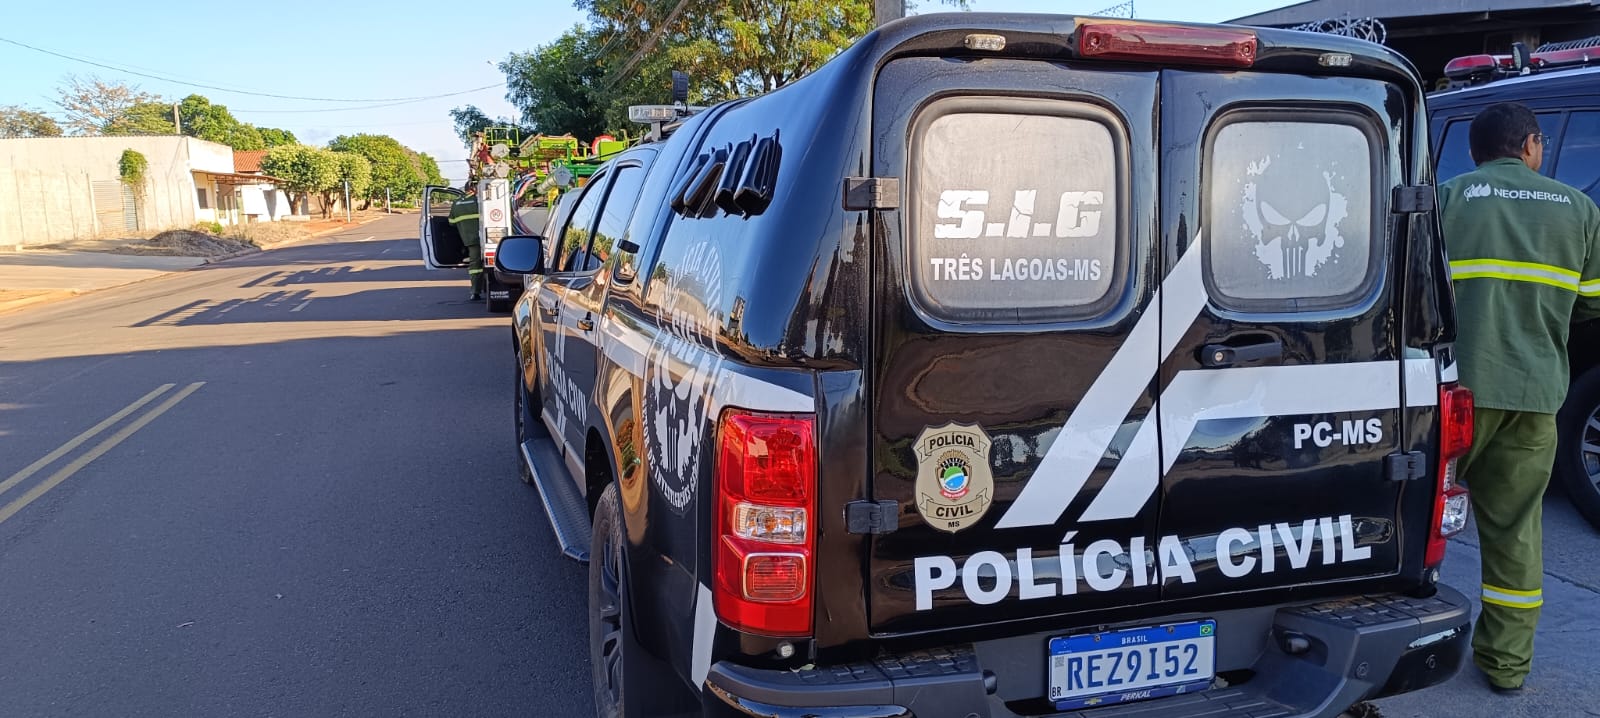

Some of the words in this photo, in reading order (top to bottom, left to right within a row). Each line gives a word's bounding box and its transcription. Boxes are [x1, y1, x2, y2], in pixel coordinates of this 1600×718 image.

[1493, 187, 1571, 205] NEOENERGIA
[934, 189, 1104, 239] S.I.G
[931, 253, 983, 281] TRÊS
[990, 258, 1102, 281] LAGOAS-MS
[929, 432, 975, 450] POLÍCIA
[1293, 418, 1383, 449] PC-MS
[936, 505, 974, 518] CIVIL
[914, 530, 1196, 611] POLÍCIA
[1215, 513, 1372, 578] CIVIL
[1121, 636, 1148, 645] BRASIL
[1067, 643, 1199, 691] REZ9I52
[1051, 686, 1062, 697] BR
